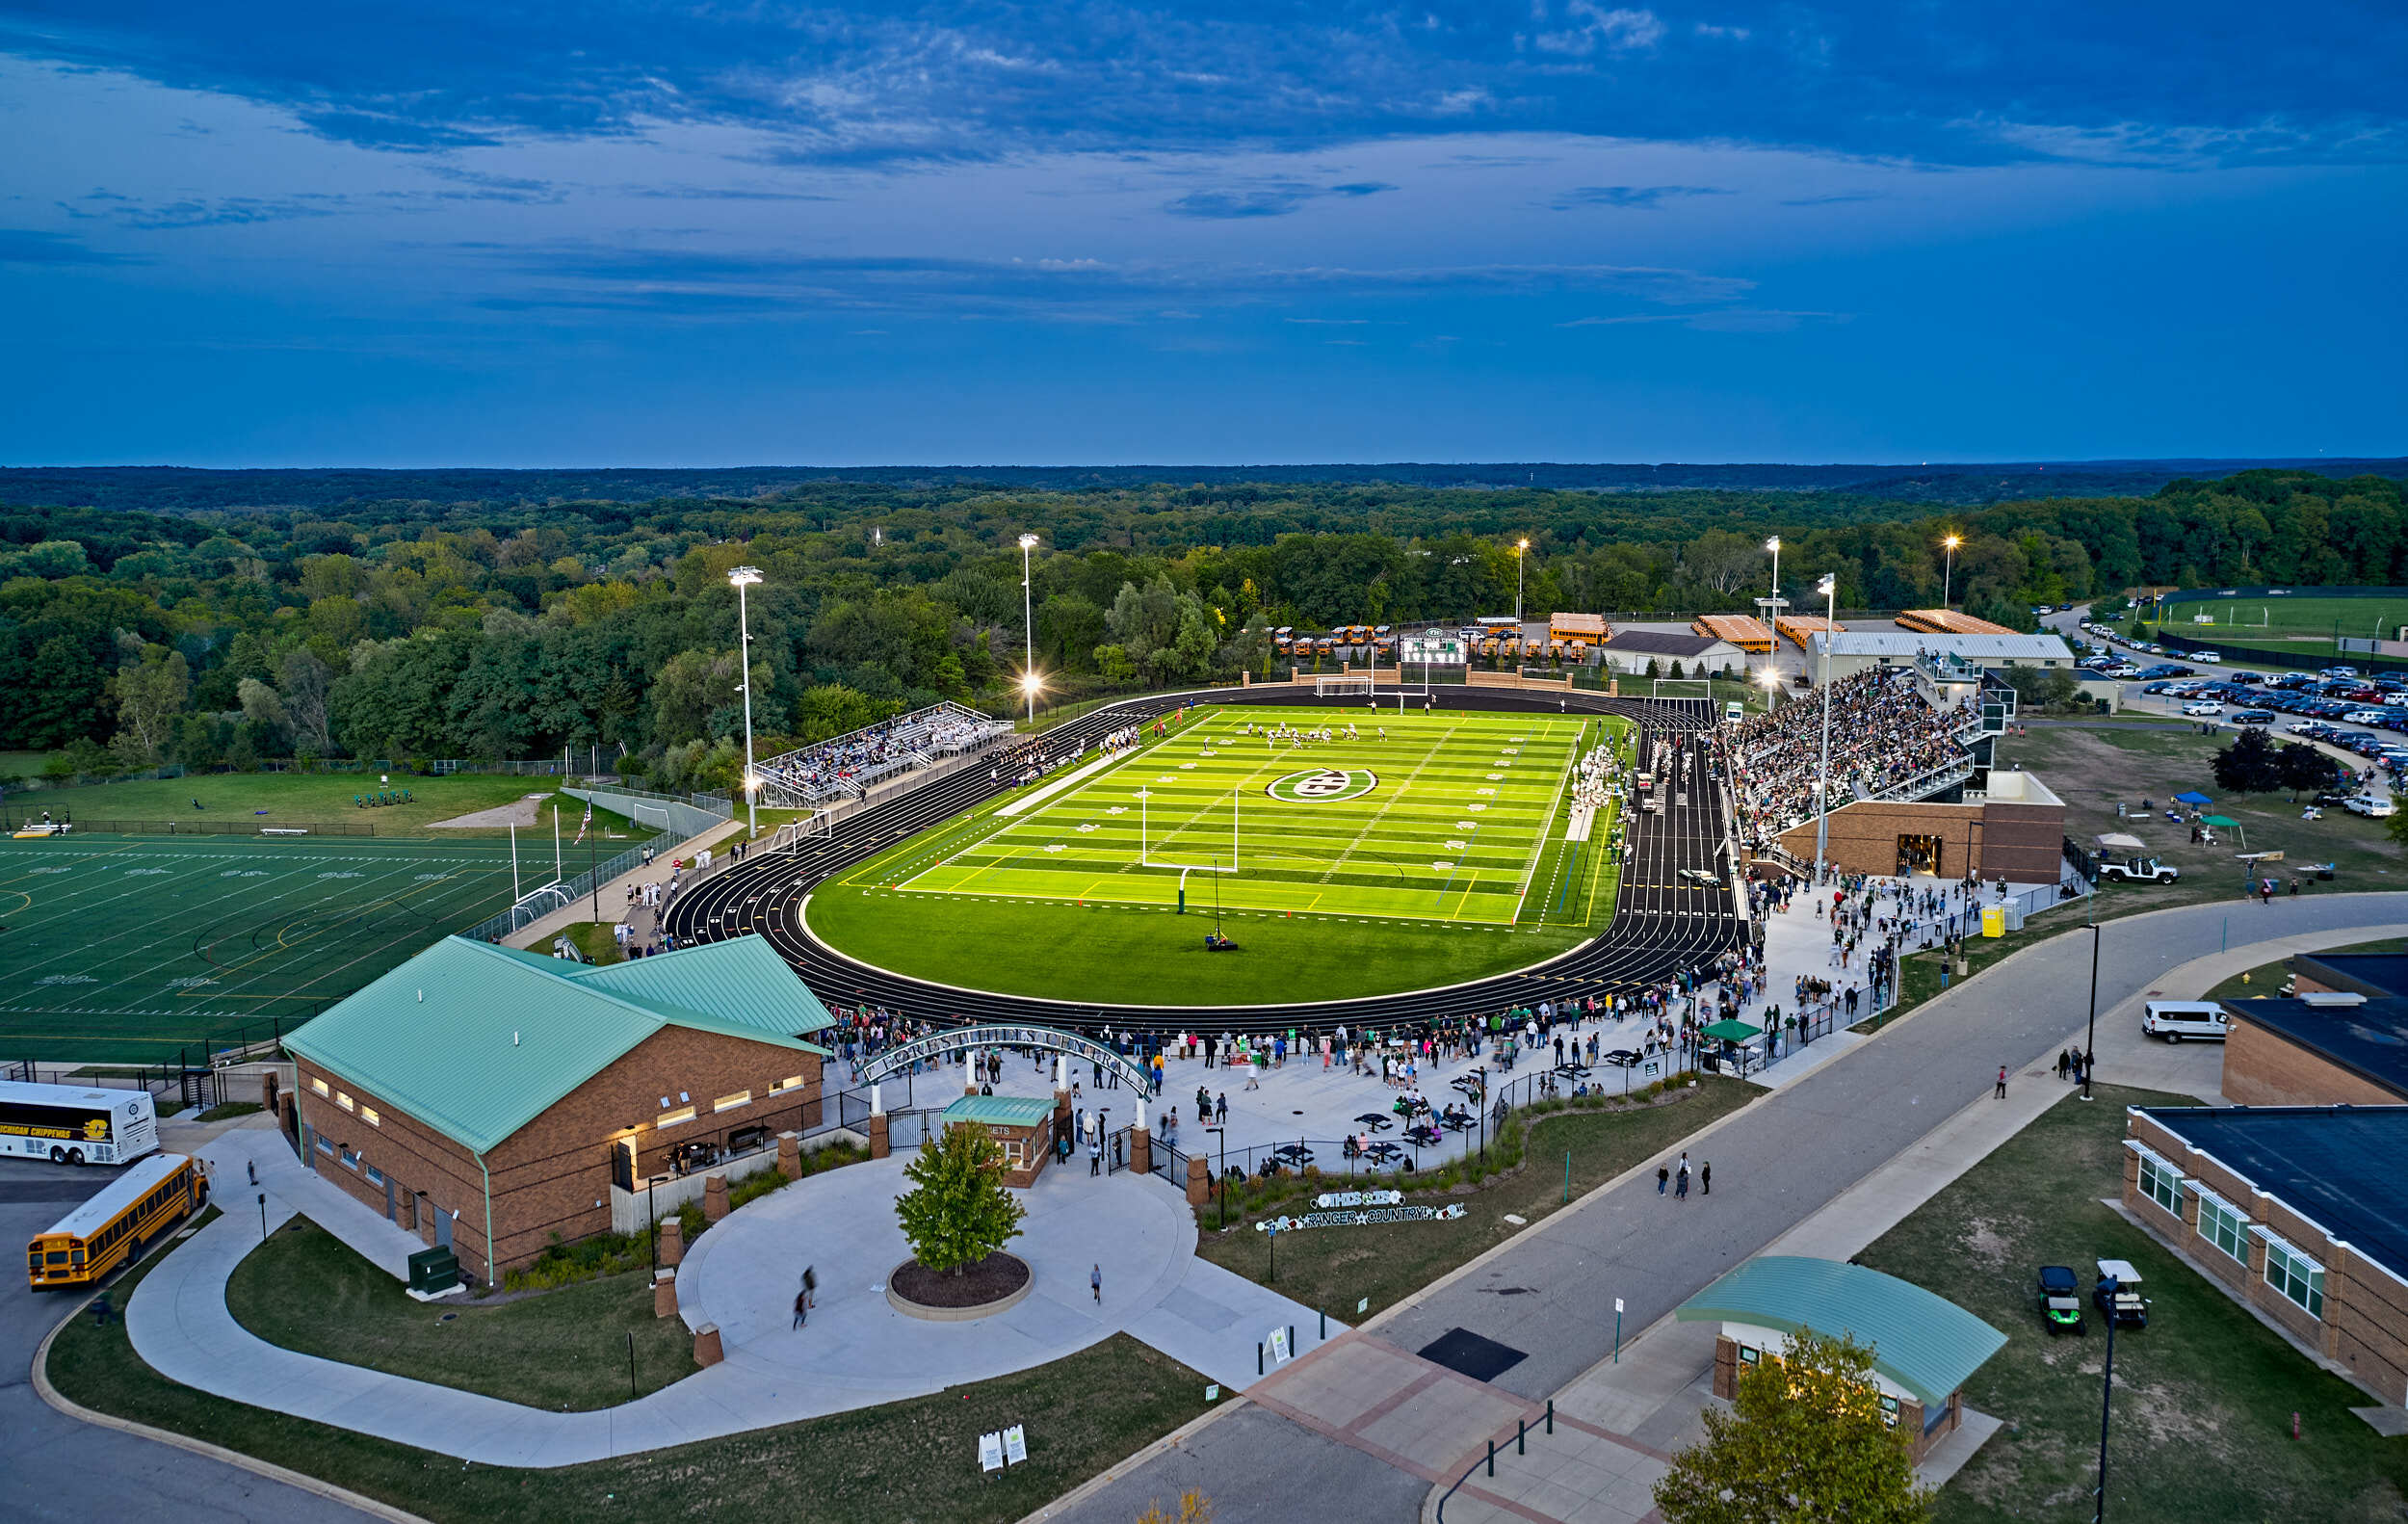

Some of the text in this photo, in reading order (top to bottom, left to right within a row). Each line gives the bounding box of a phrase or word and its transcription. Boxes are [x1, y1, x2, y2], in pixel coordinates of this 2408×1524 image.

[0, 1124, 71, 1139] ICHIGAN CHIPPEWAS
[1329, 1191, 1391, 1207] THIS IS
[1307, 1206, 1428, 1228] RANGER COUNTRY!
